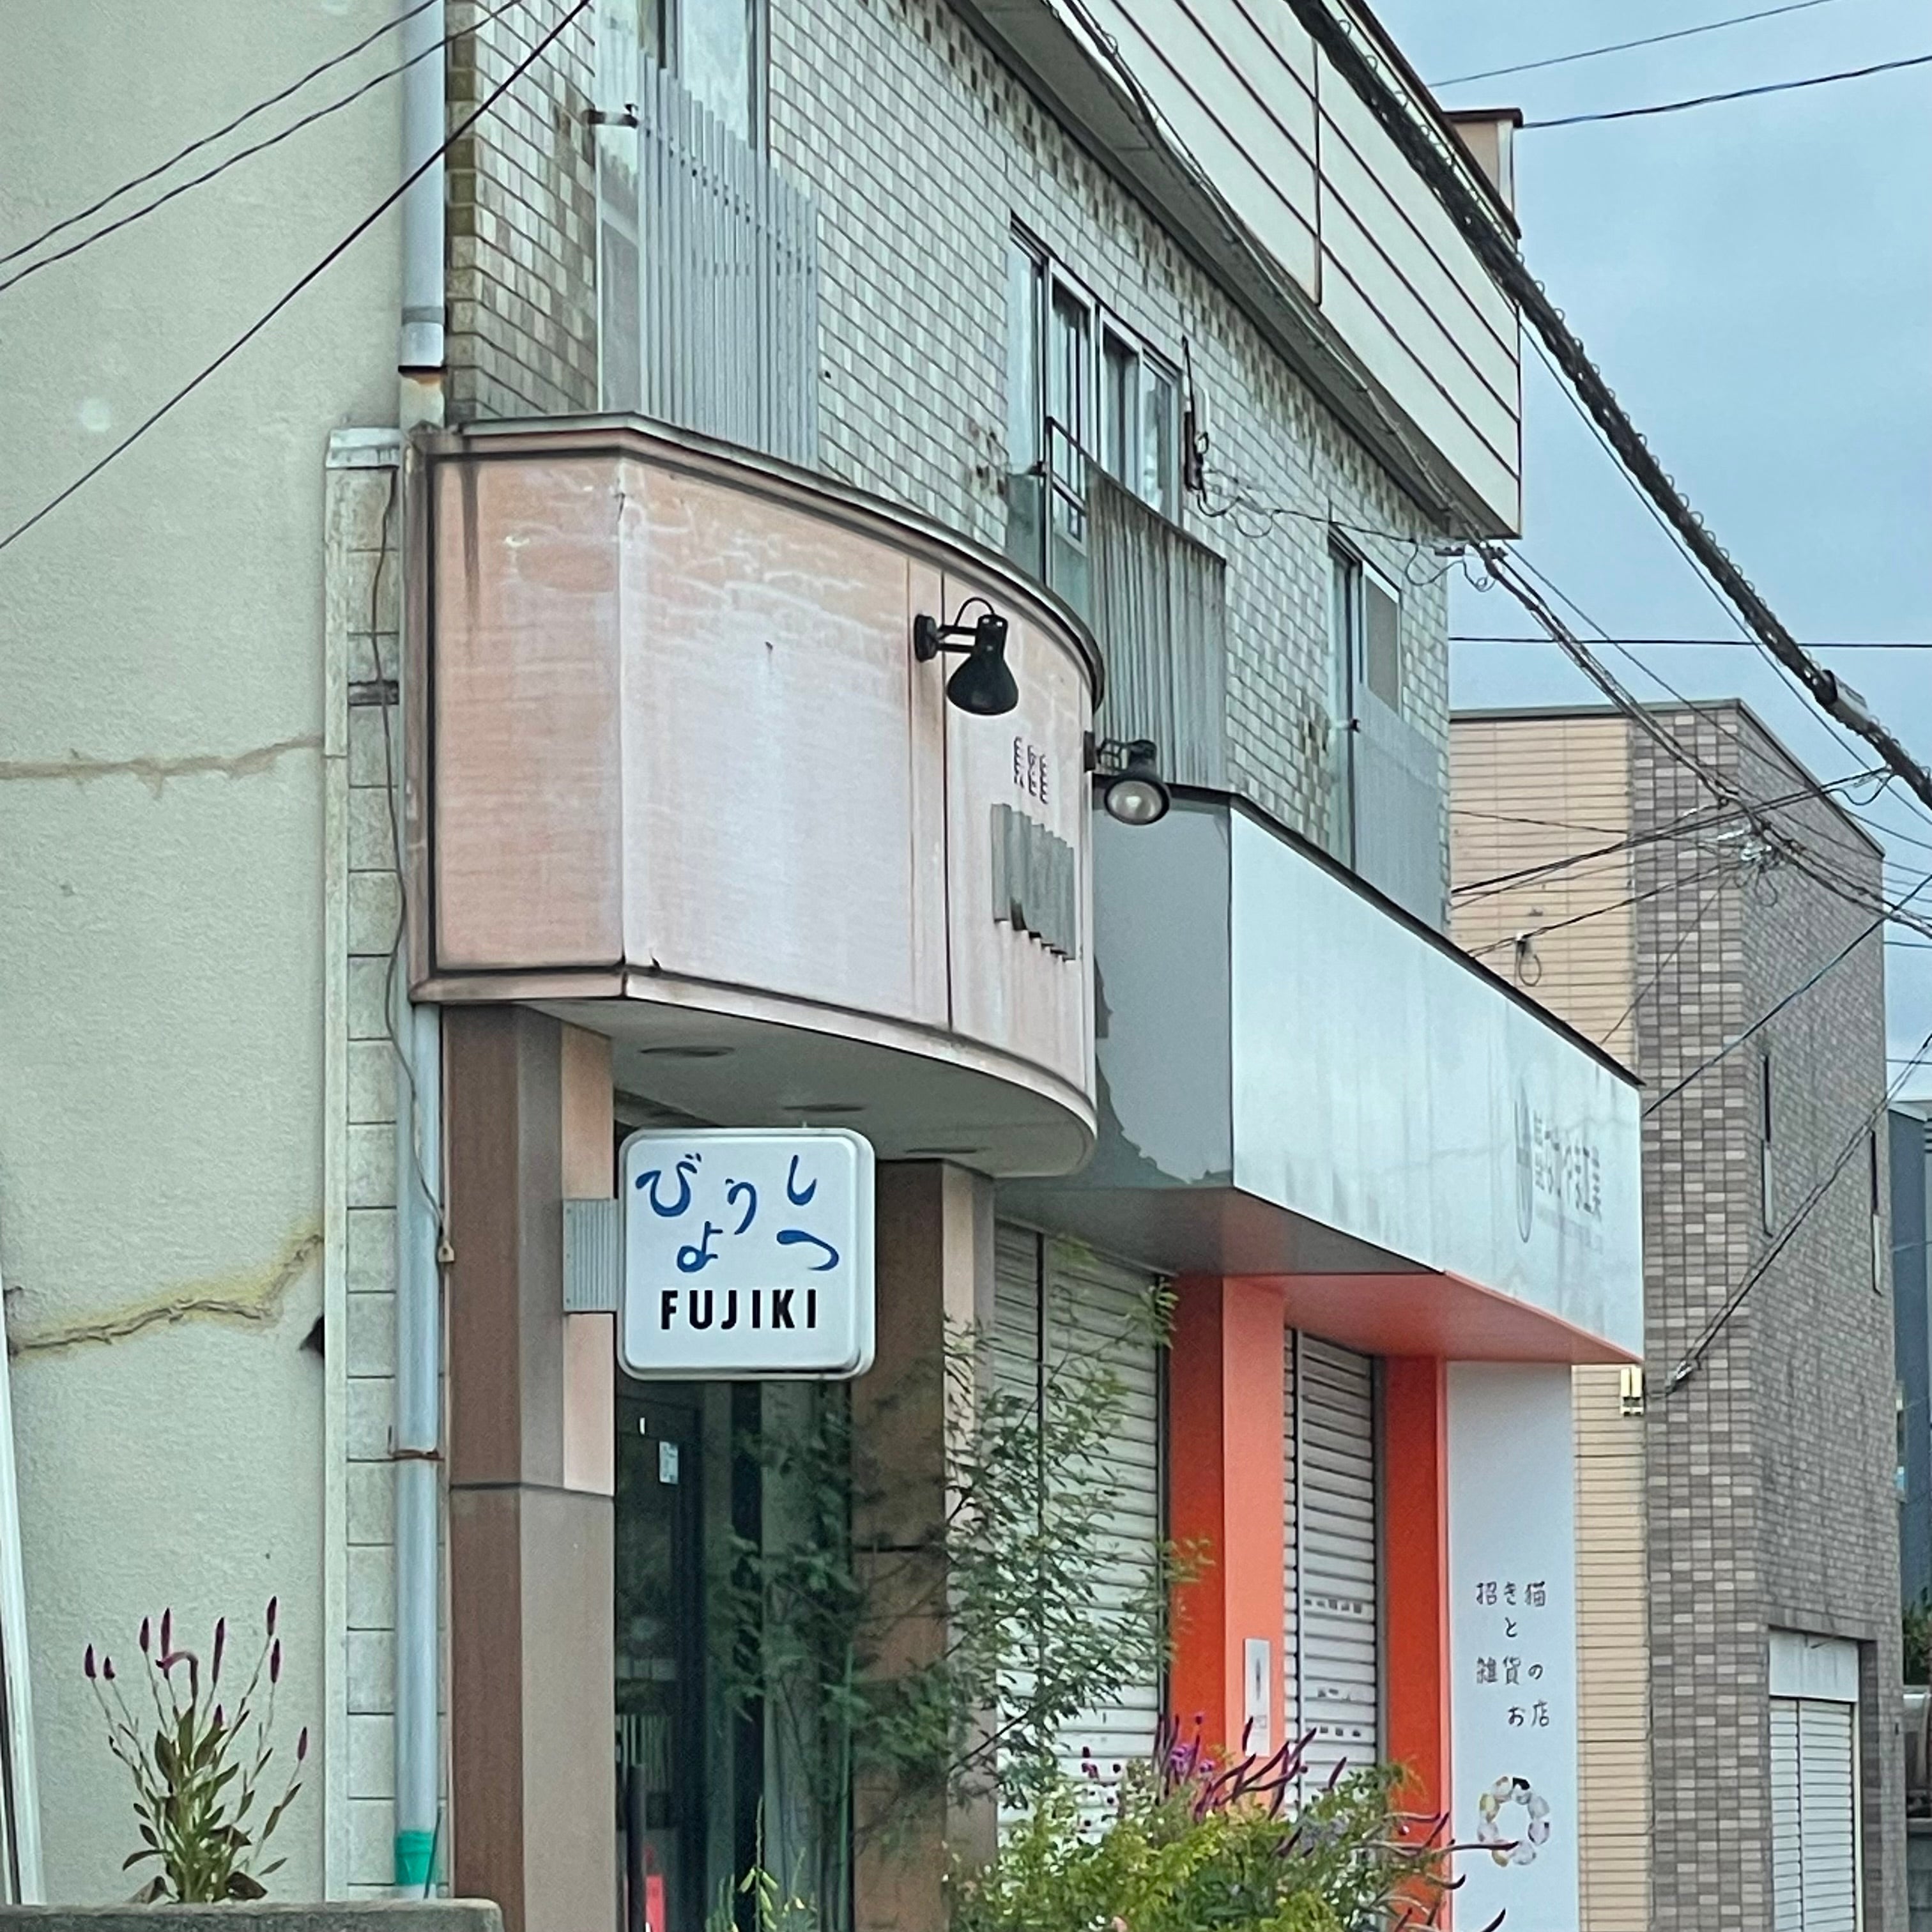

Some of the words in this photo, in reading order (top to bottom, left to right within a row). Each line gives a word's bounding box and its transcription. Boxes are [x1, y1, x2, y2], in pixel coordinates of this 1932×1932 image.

[661, 1289, 816, 1330] FUJIKI
[1504, 1616, 1518, 1638] と
[1507, 1699, 1550, 1727] お店
